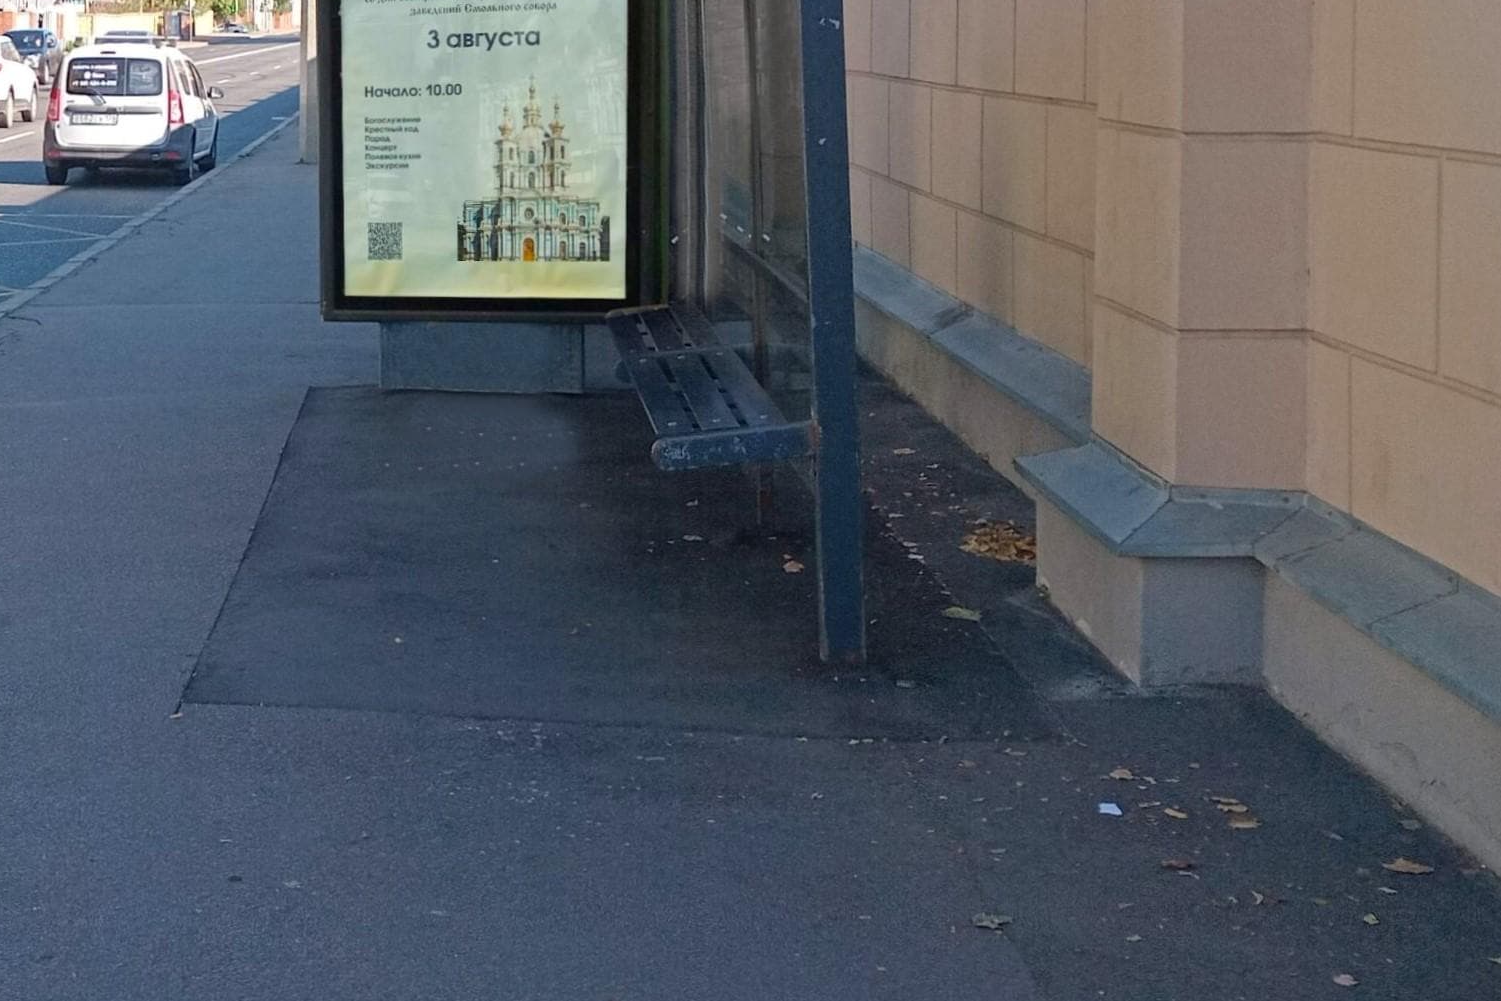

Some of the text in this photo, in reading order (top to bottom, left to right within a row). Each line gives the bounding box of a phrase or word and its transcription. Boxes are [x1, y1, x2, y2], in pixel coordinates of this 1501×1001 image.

[427, 29, 541, 51] 3 августа
[364, 83, 462, 98] Начало: 10.00
